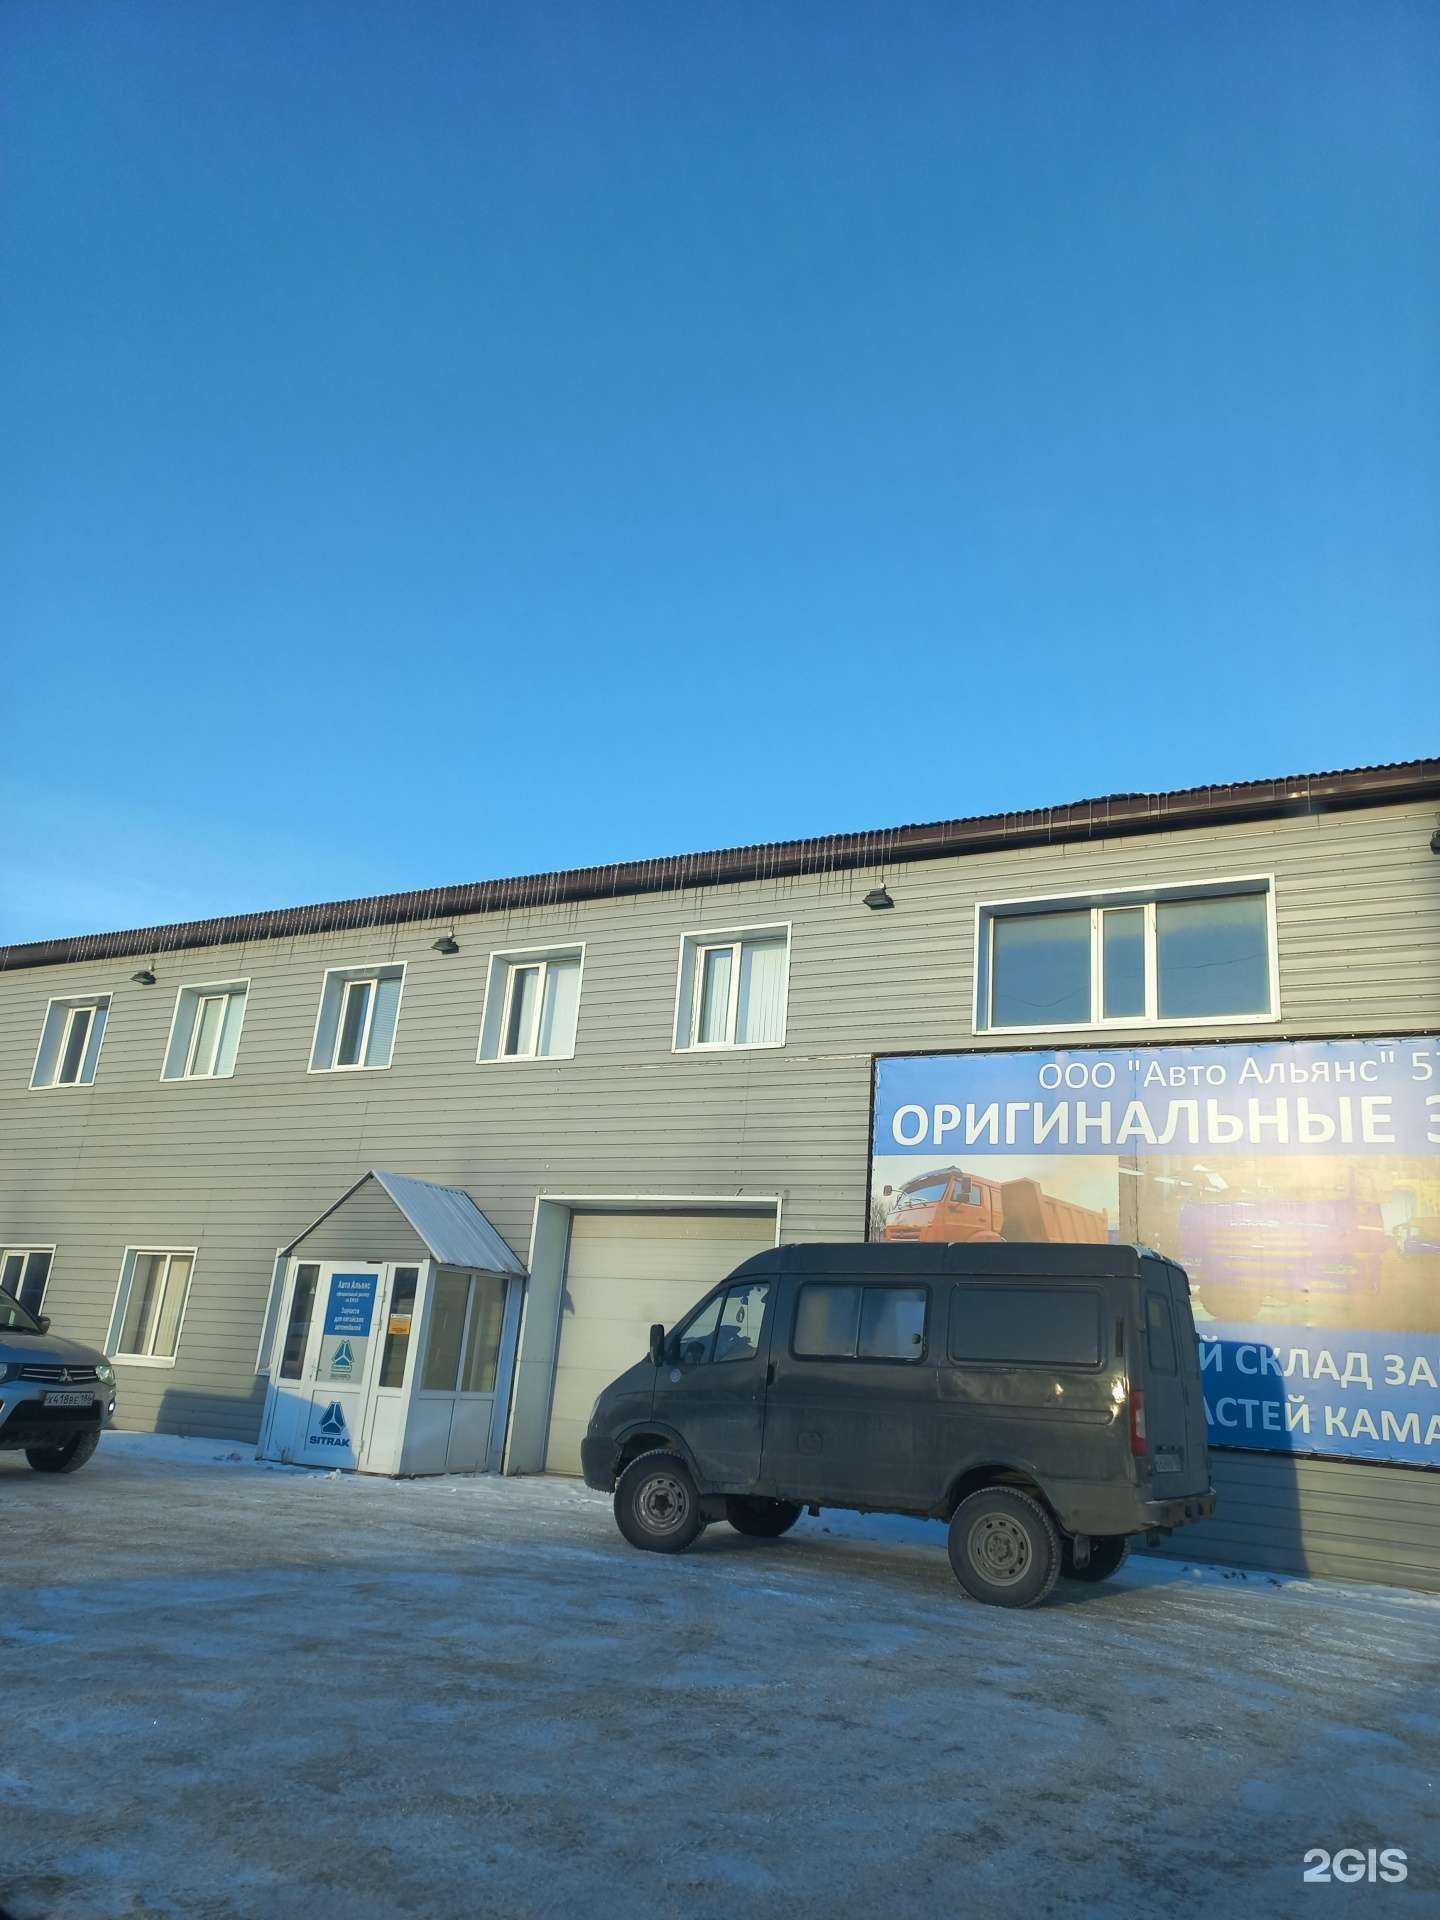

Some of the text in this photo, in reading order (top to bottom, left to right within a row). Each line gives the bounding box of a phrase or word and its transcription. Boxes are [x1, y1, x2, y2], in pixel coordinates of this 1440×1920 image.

[1038, 1050, 1440, 1089] ООО "Авто Альянс" 5
[891, 1095, 1396, 1146] ОРИГИНАЛЬНЫЕ
[1235, 1345, 1373, 1391] СКЛАД
[1383, 1354, 1440, 1389] ЗА
[309, 1435, 350, 1448] SITRAK
